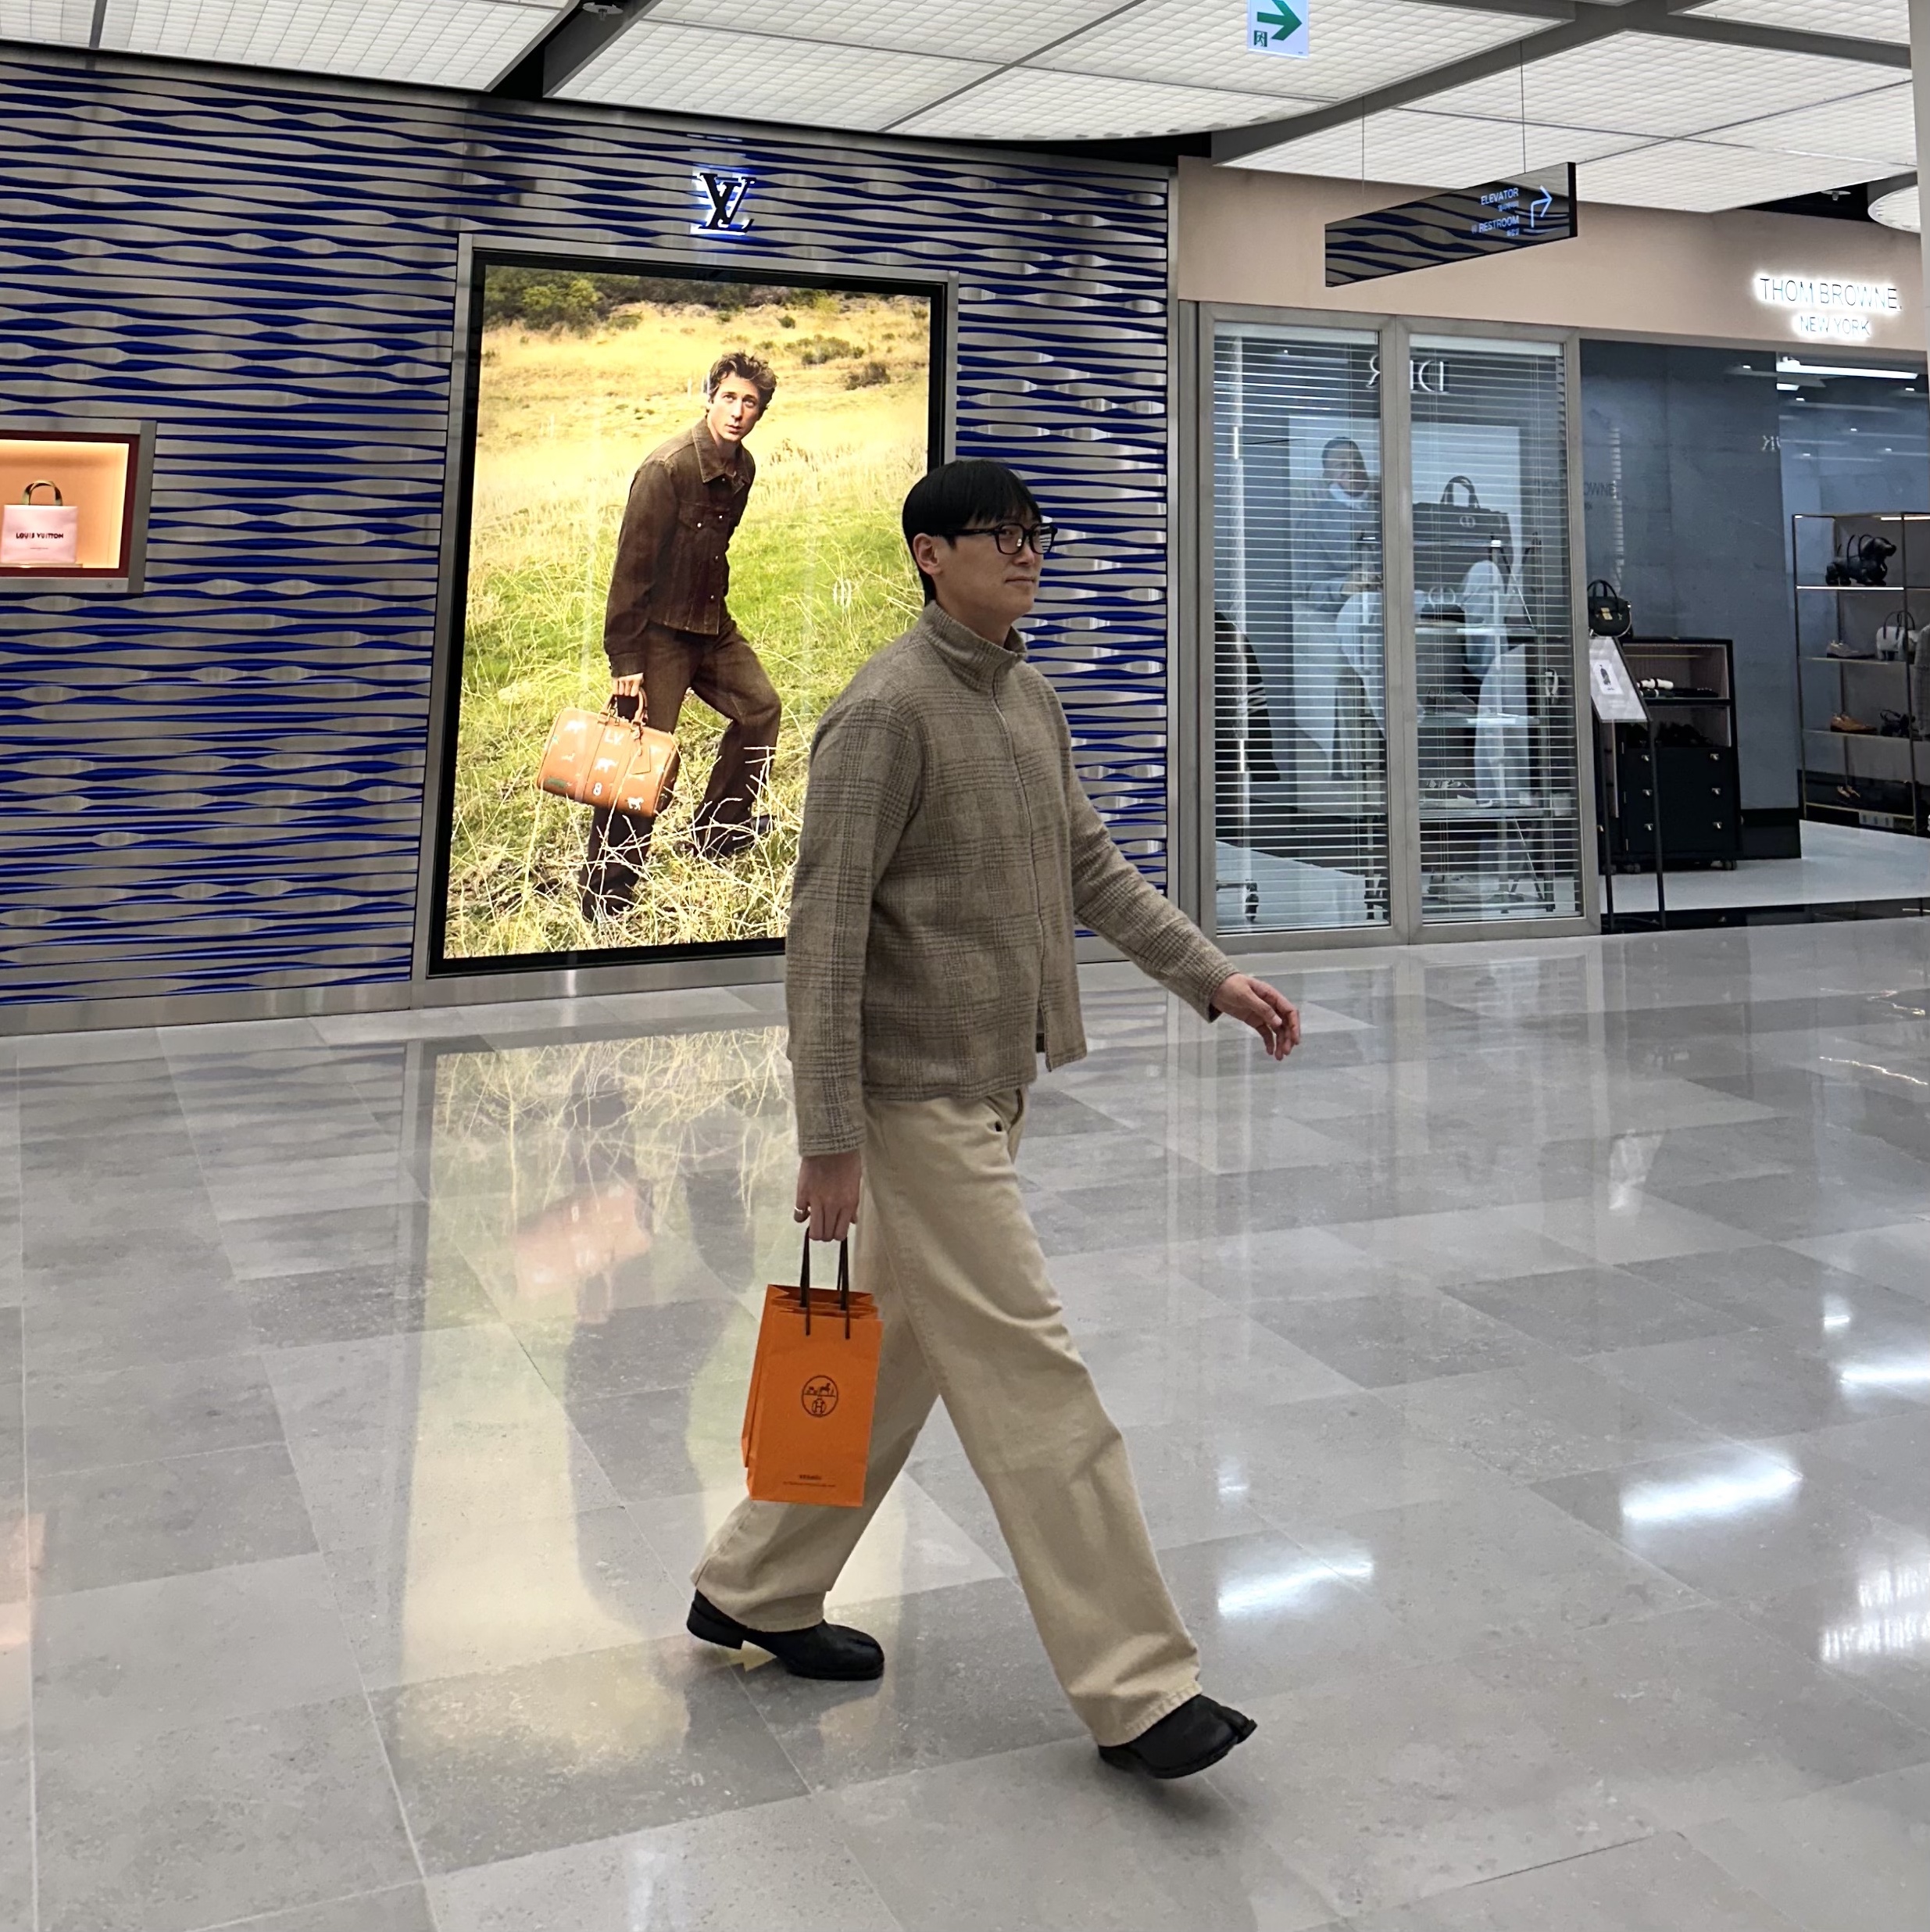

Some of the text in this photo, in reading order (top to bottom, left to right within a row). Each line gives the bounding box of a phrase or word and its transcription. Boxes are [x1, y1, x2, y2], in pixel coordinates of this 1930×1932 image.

[1481, 188, 1519, 205] ELEVATOR
[1479, 216, 1519, 233] RESTROOM
[1760, 278, 1814, 302] THOM
[1800, 316, 1871, 336] NEW YORK
